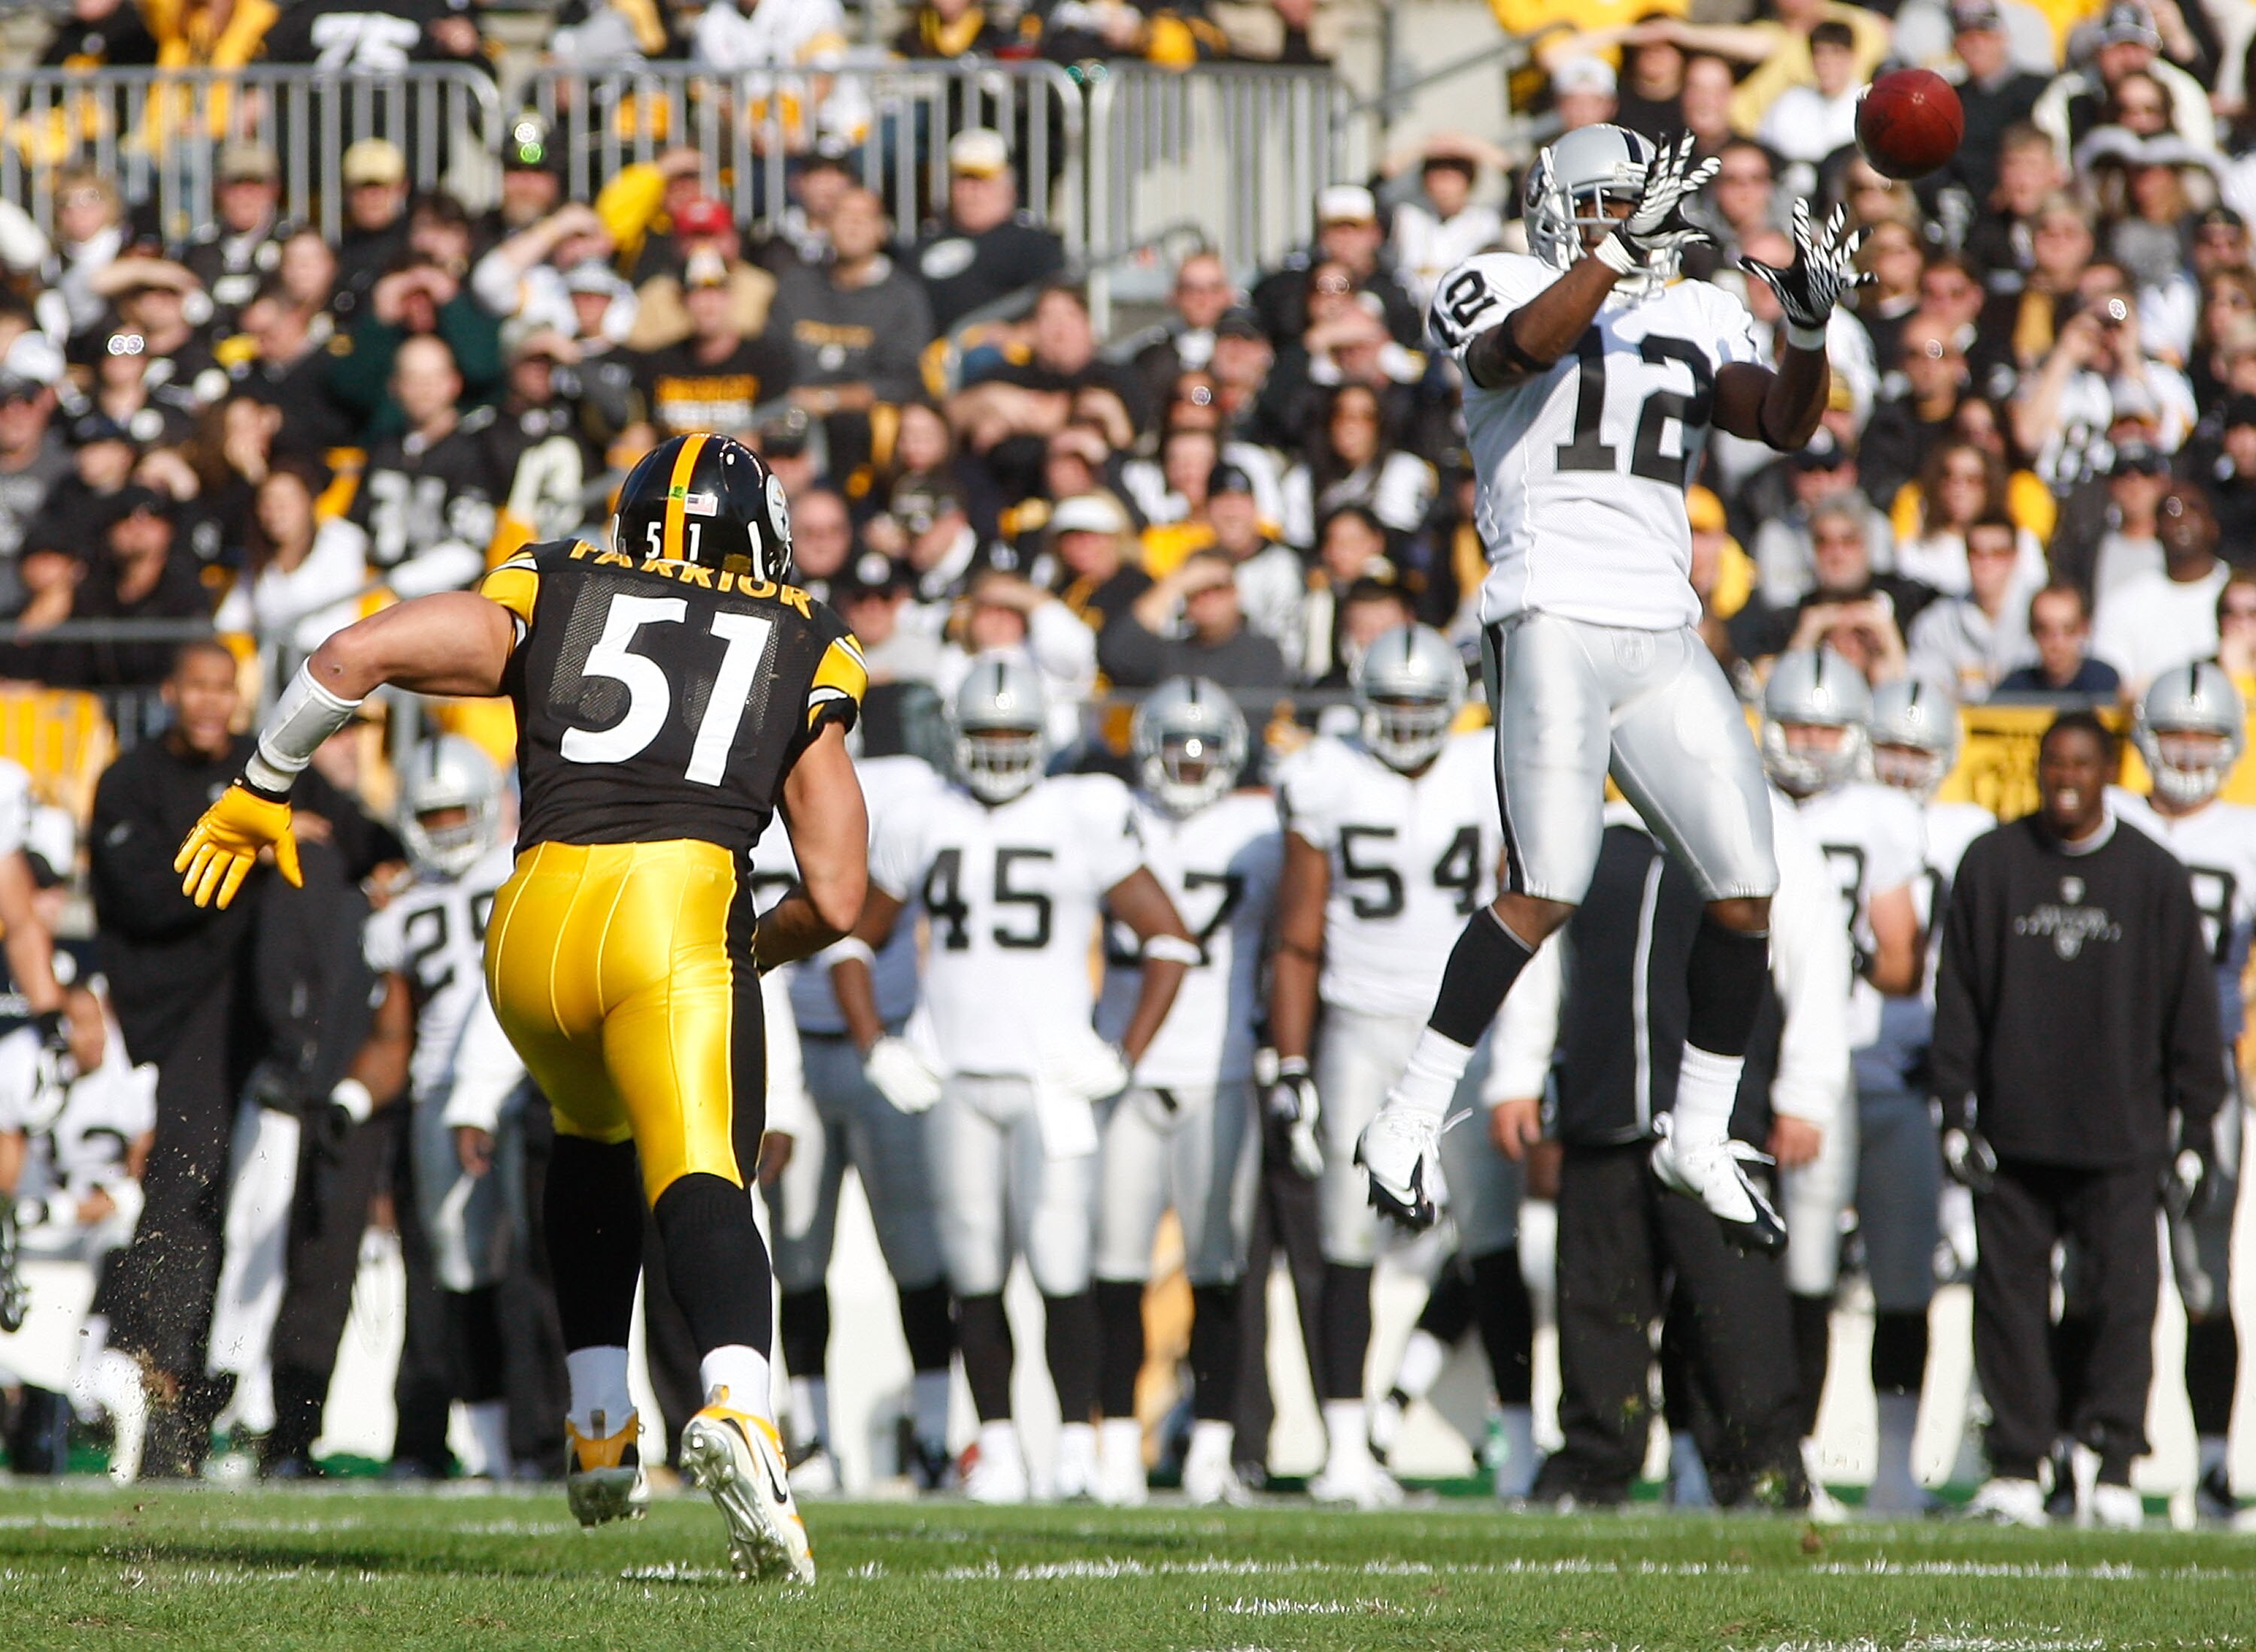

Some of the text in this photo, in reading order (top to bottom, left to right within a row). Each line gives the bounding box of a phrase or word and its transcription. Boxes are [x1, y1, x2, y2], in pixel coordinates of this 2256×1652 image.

[1556, 325, 1713, 489] 12
[645, 521, 702, 562] 51
[560, 593, 772, 787] 51
[923, 847, 1054, 948] 45
[1339, 826, 1480, 918] 54
